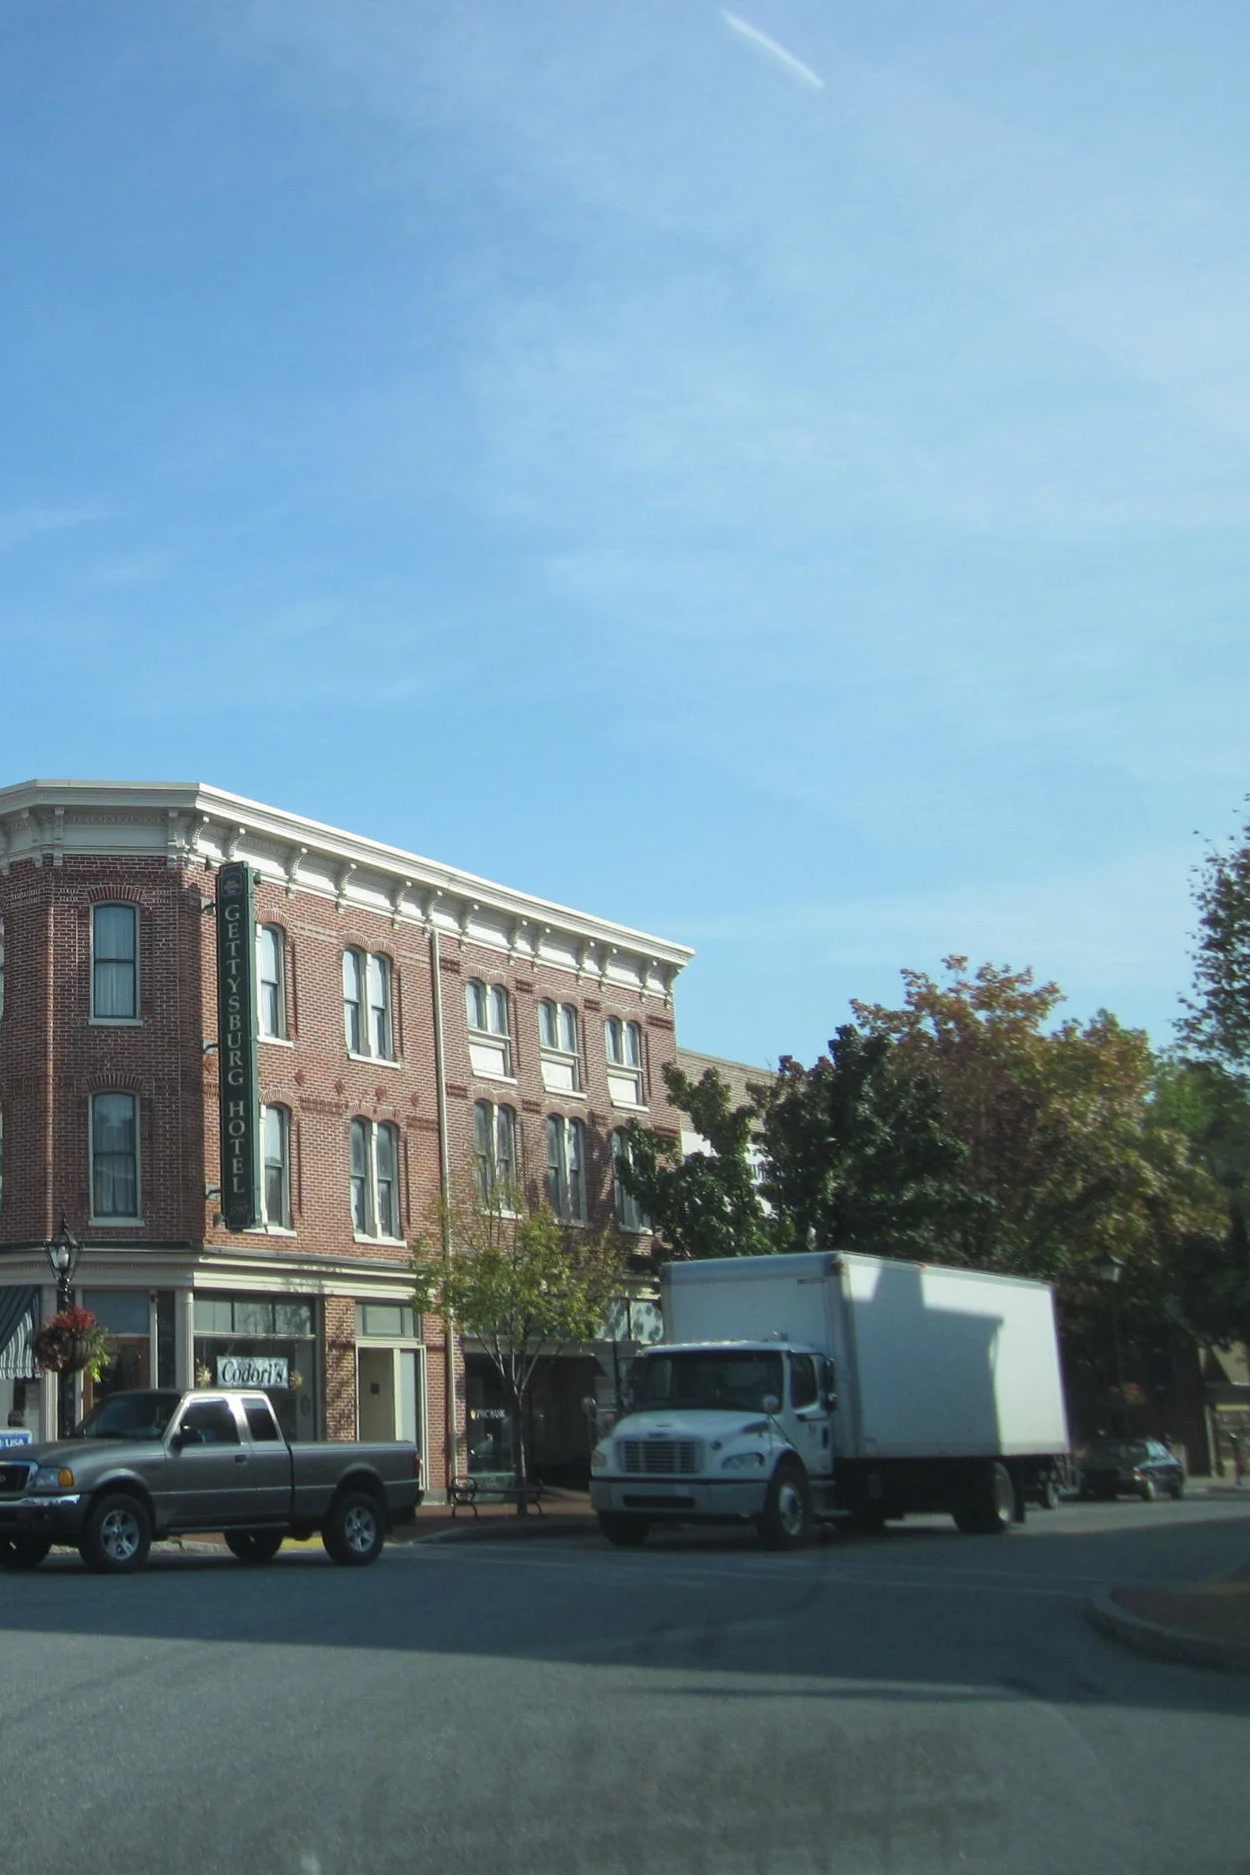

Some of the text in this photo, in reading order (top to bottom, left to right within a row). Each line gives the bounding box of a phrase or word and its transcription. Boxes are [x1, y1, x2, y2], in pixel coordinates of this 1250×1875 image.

[224, 904, 244, 1086] GETTYSBURG
[228, 1101, 245, 1193] HOTEL
[221, 1360, 284, 1384] Codori's
